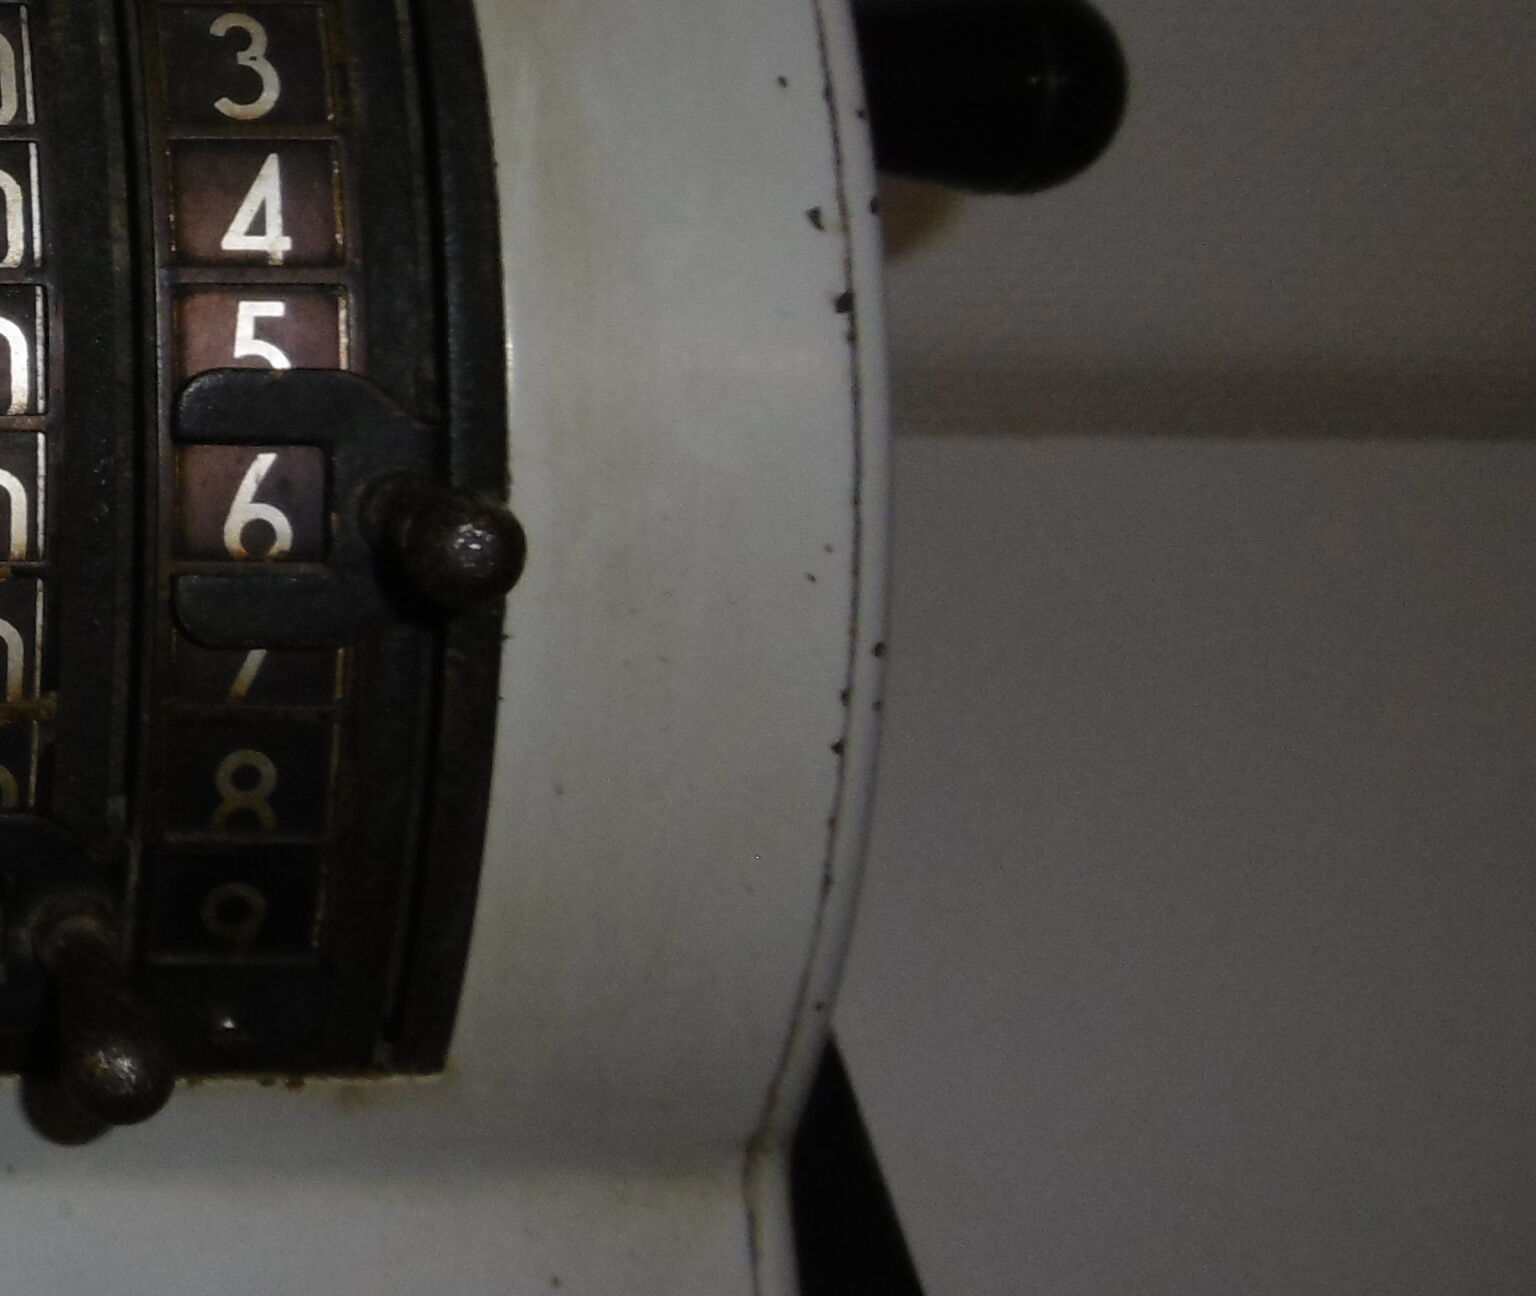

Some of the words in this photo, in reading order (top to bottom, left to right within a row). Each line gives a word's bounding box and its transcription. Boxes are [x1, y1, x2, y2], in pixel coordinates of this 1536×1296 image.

[207, 15, 281, 120] 3
[220, 152, 294, 267] 4
[232, 301, 292, 370] 5
[223, 451, 294, 558] 6
[211, 748, 279, 834] 8
